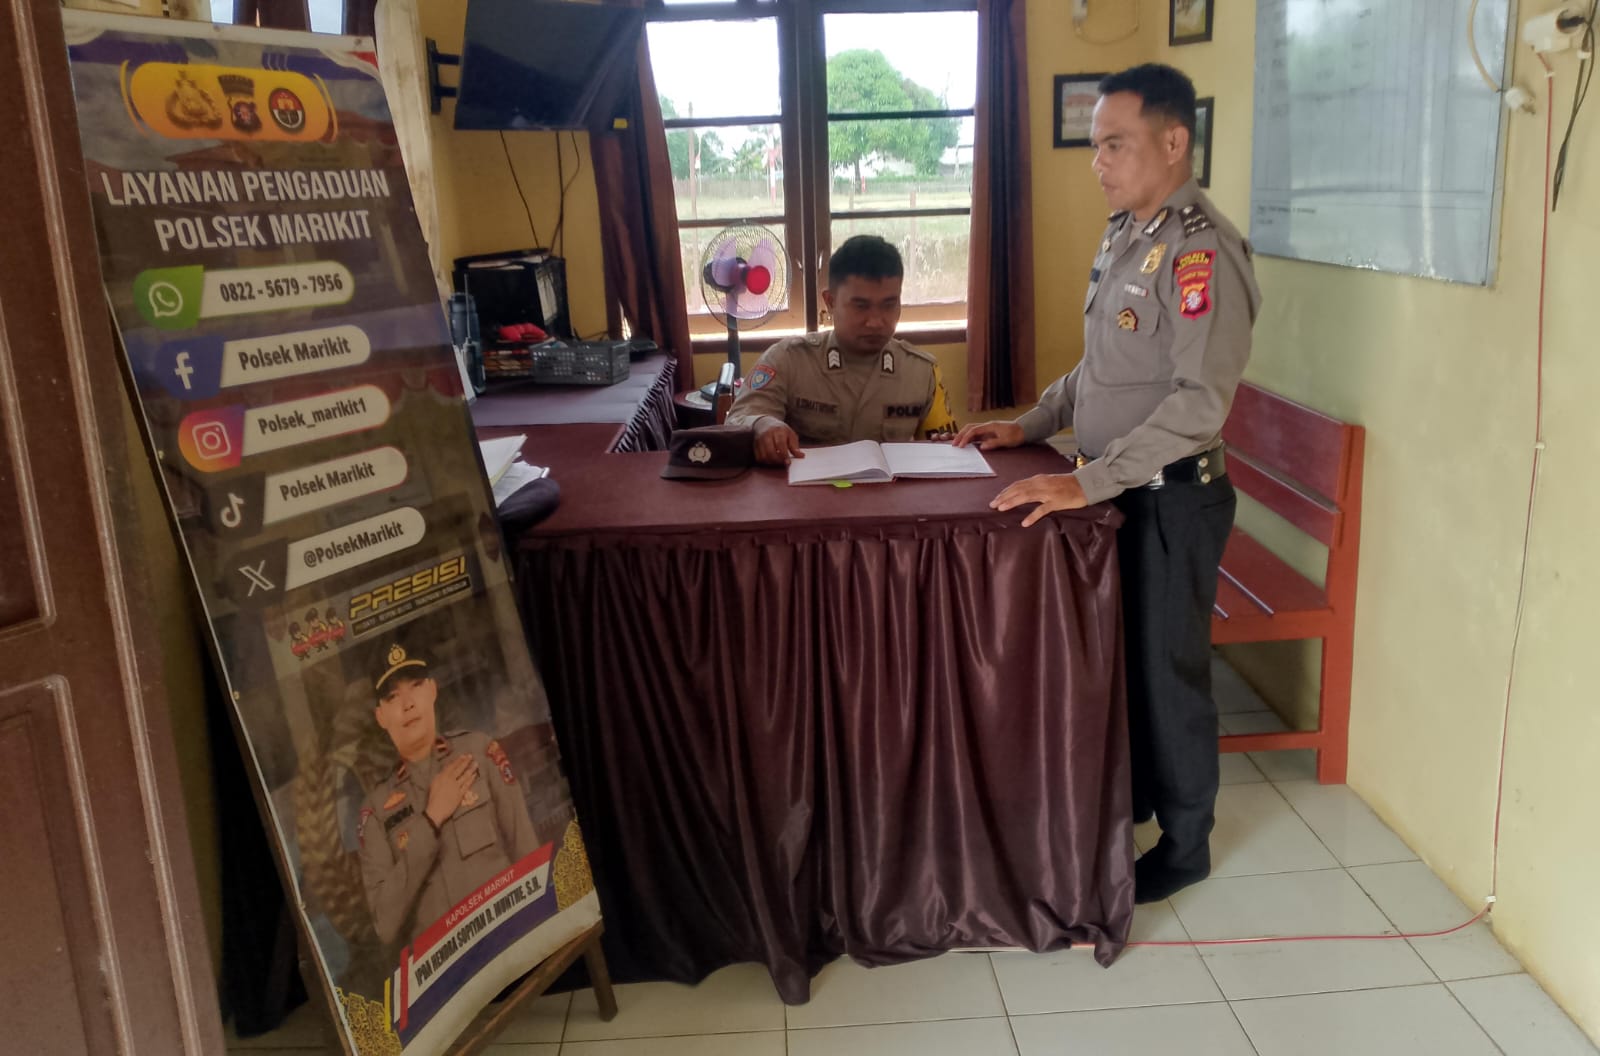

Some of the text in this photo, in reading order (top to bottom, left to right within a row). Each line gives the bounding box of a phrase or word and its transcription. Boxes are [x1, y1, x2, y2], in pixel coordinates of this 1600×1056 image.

[101, 169, 390, 206] LAYANAN PENGADUAN
[154, 209, 372, 252] POLSEK MARIKIT
[238, 336, 351, 371] Polsek Marikit
[257, 397, 368, 435] Polsek_marikit1
[279, 462, 376, 502] Polsek Marikit
[303, 521, 404, 568] @PolsekMarikit
[445, 869, 515, 928] KAPOLSEK MARIKIT
